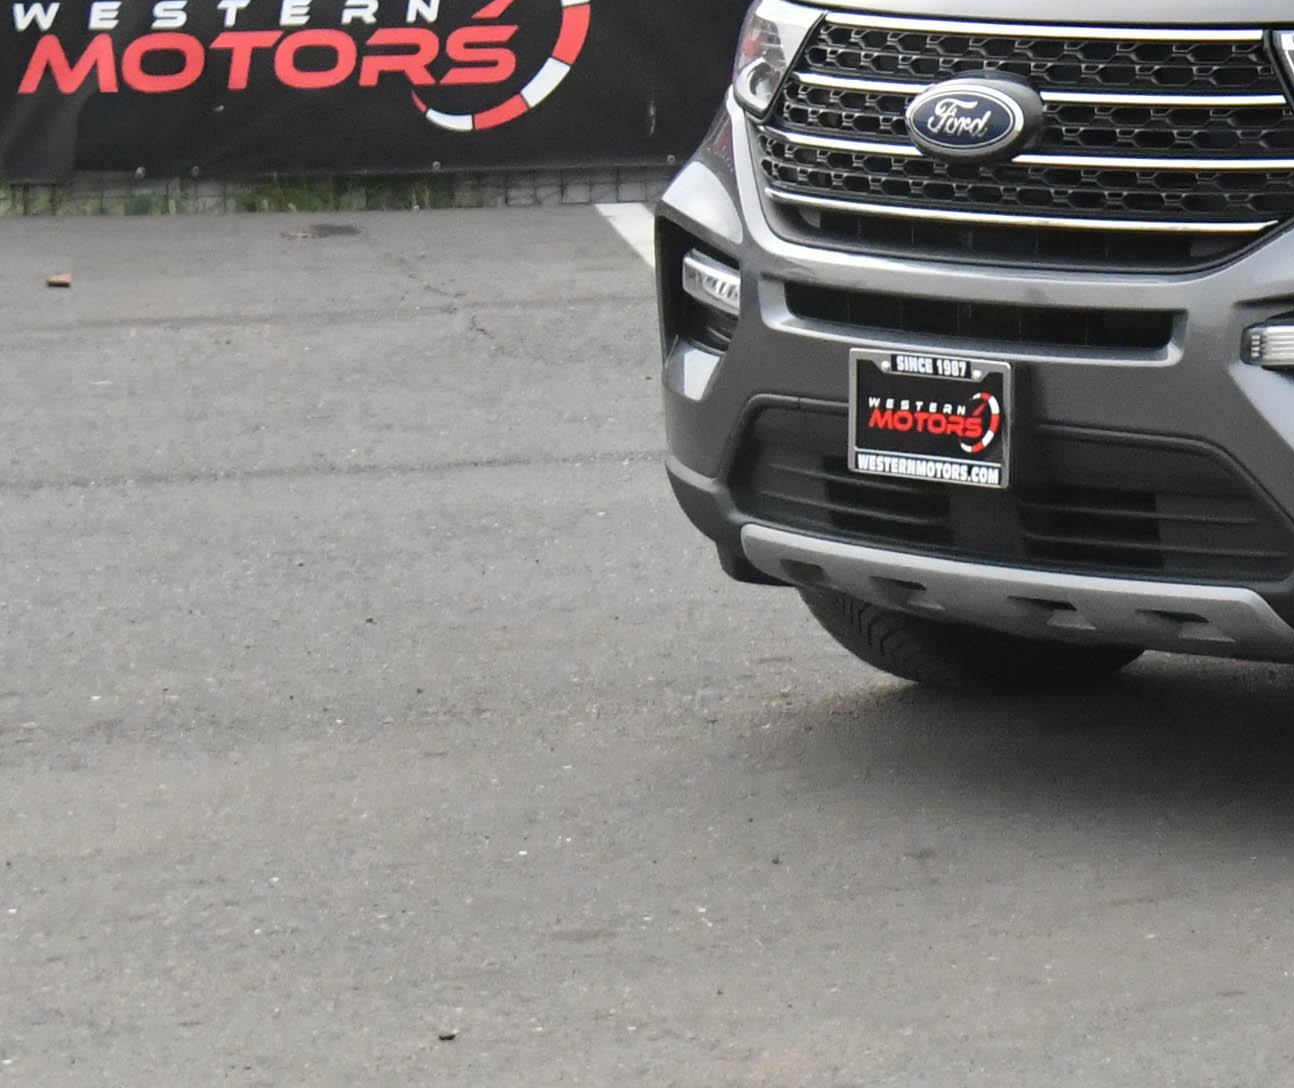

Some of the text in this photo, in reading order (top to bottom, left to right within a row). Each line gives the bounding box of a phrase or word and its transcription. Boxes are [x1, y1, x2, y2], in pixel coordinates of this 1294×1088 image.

[18, 24, 518, 94] MOTORS
[927, 97, 992, 137] Ford
[896, 354, 934, 374] SINCE
[868, 396, 967, 416] WESTERN
[868, 407, 984, 439] MOTORS
[857, 453, 1000, 486] WESTERNMOTORS.COM
